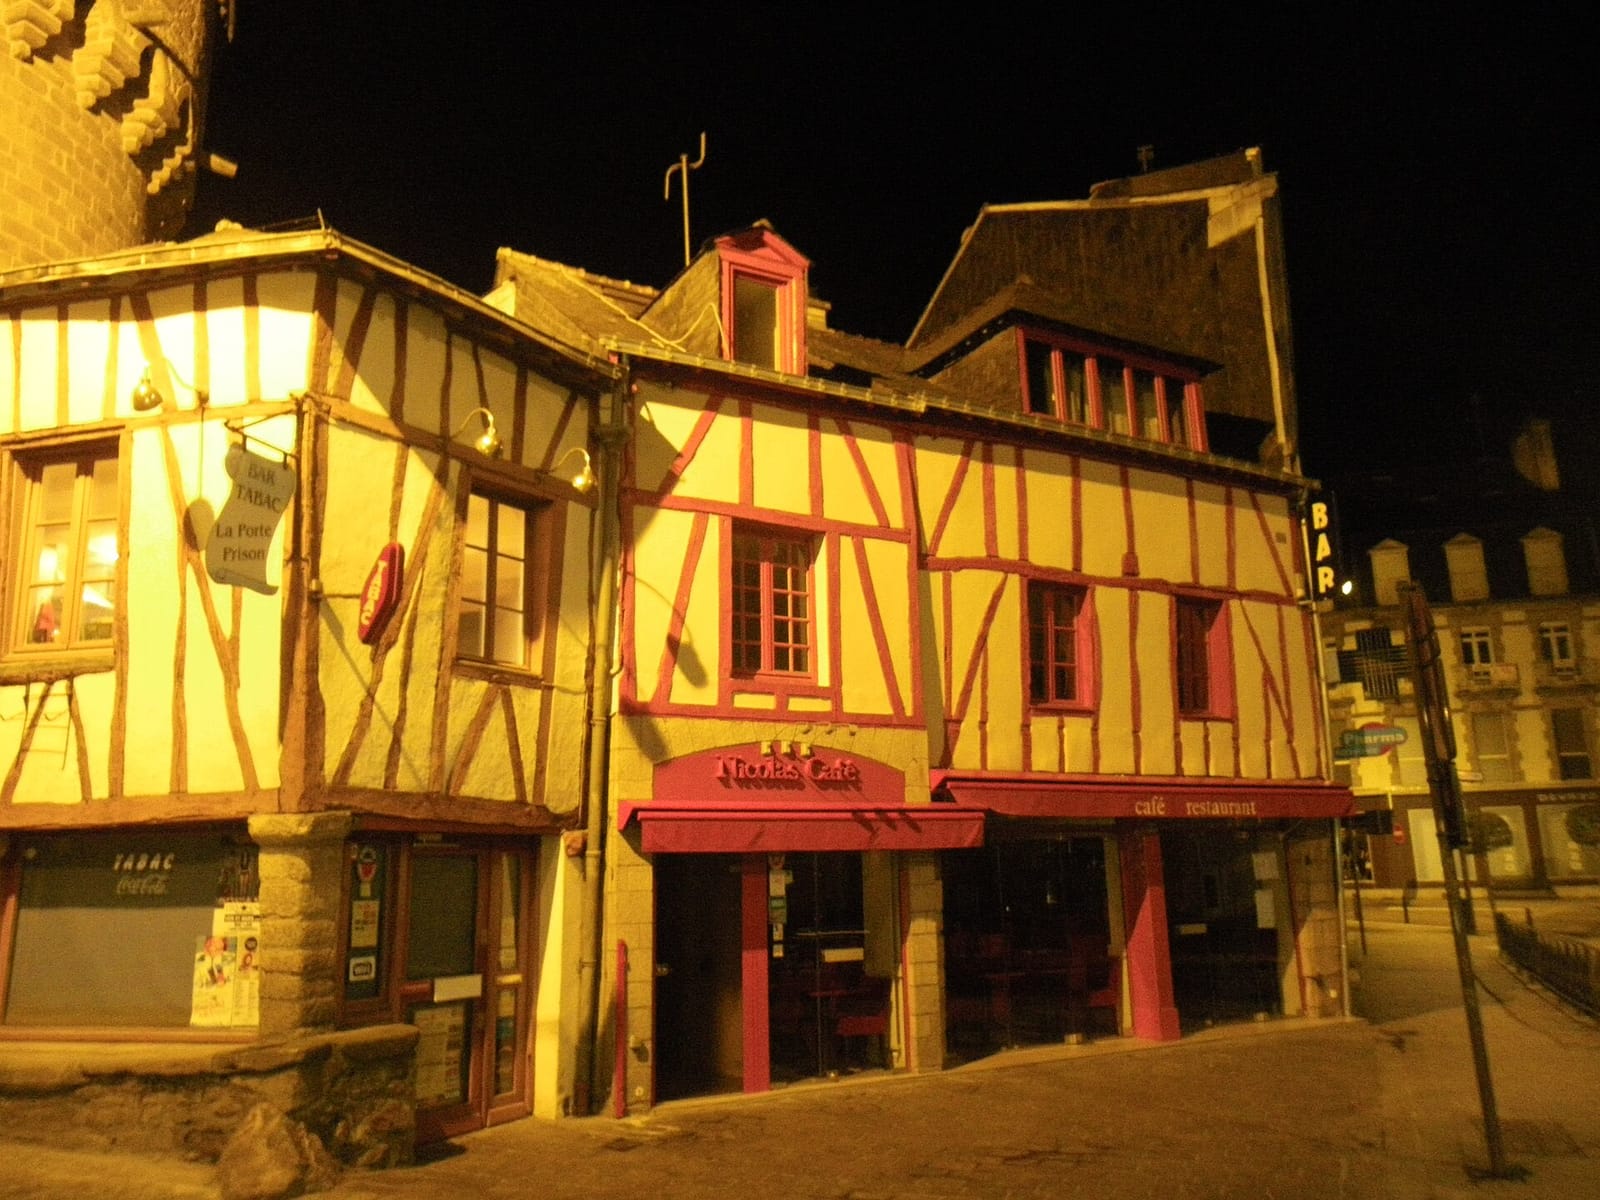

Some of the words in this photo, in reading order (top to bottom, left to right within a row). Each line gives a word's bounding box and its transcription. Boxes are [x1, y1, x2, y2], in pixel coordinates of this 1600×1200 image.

[247, 463, 276, 484] BAR
[236, 484, 281, 514] TABAC
[216, 523, 233, 538] La
[238, 522, 272, 538] Porte
[223, 547, 265, 561] Prison
[1312, 502, 1335, 593] BAR
[360, 560, 388, 626] TABAC
[714, 754, 801, 780] Nicolas
[803, 757, 859, 781] Café
[1135, 795, 1165, 815] café
[1186, 801, 1257, 816] restaurant
[113, 852, 175, 871] TABAC
